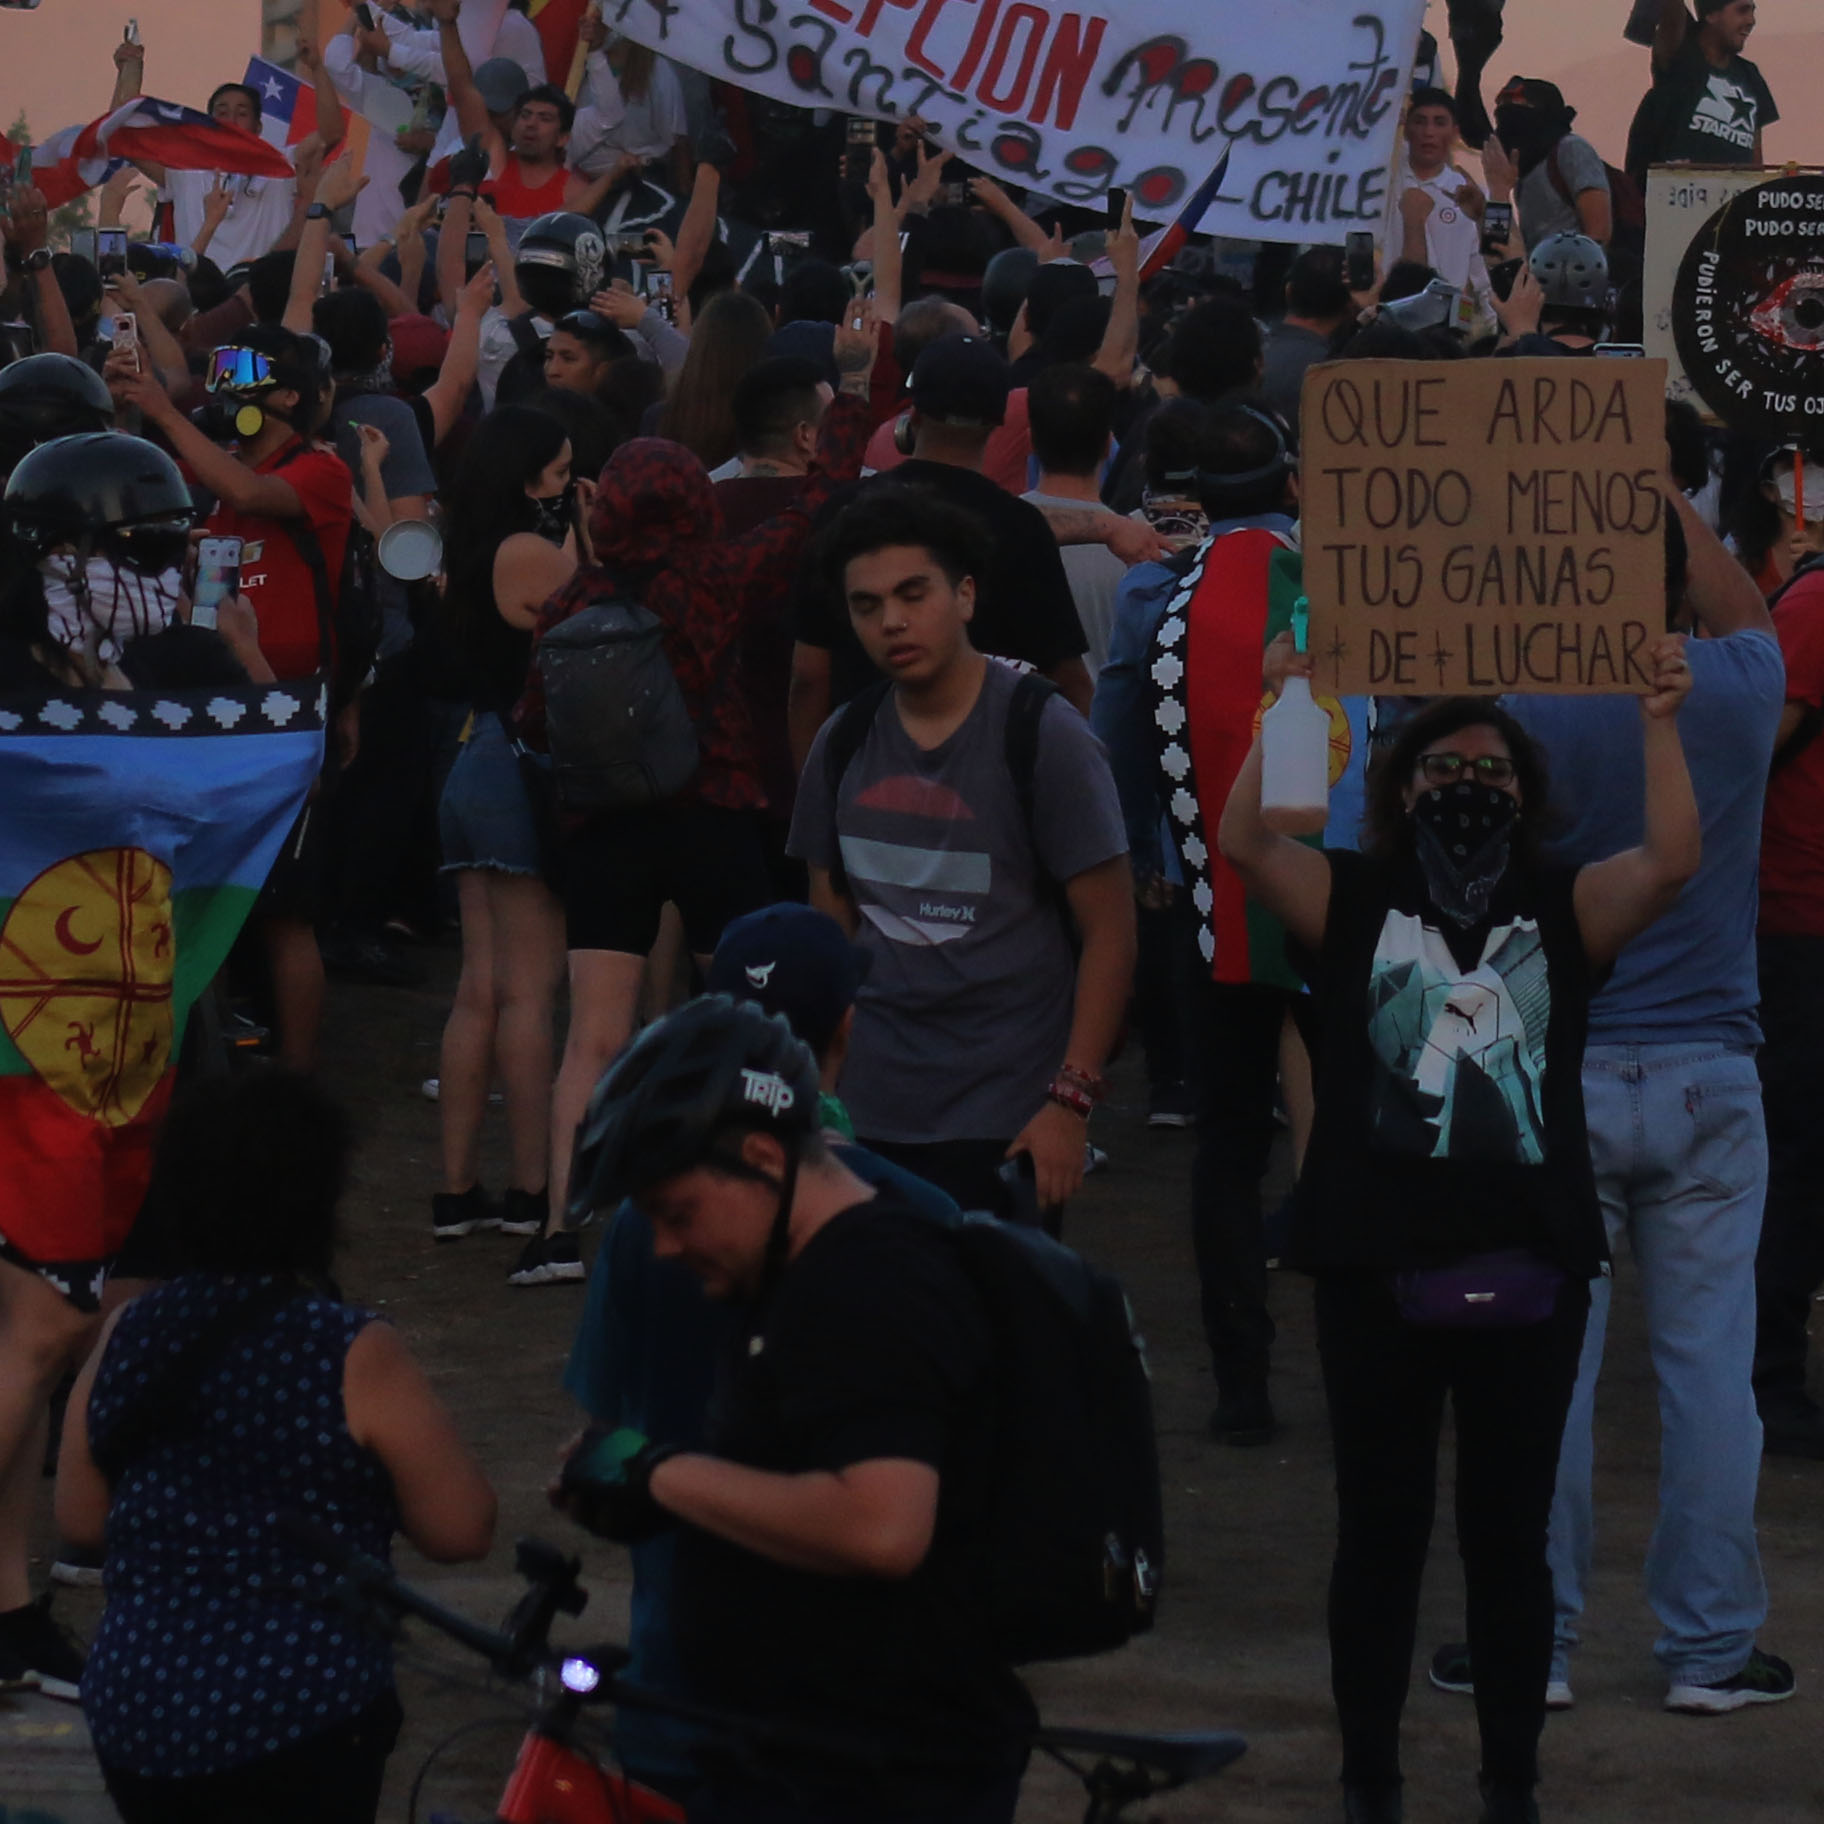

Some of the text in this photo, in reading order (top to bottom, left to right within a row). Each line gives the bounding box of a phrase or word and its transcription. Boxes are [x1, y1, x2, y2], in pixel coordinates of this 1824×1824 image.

[1688, 114, 1755, 150] STARTER
[1745, 218, 1794, 236] PUDO
[1758, 191, 1804, 209] PUDO
[1322, 378, 1447, 448] QUE
[1486, 377, 1633, 445] ARDA
[1715, 358, 1753, 400] SER
[1762, 390, 1797, 413] TUS
[1322, 466, 1663, 536] TODO MENOS
[1322, 544, 1615, 609] TUS GANAS
[1368, 621, 1651, 686] DE LUCHAR
[920, 902, 961, 920] Hurley
